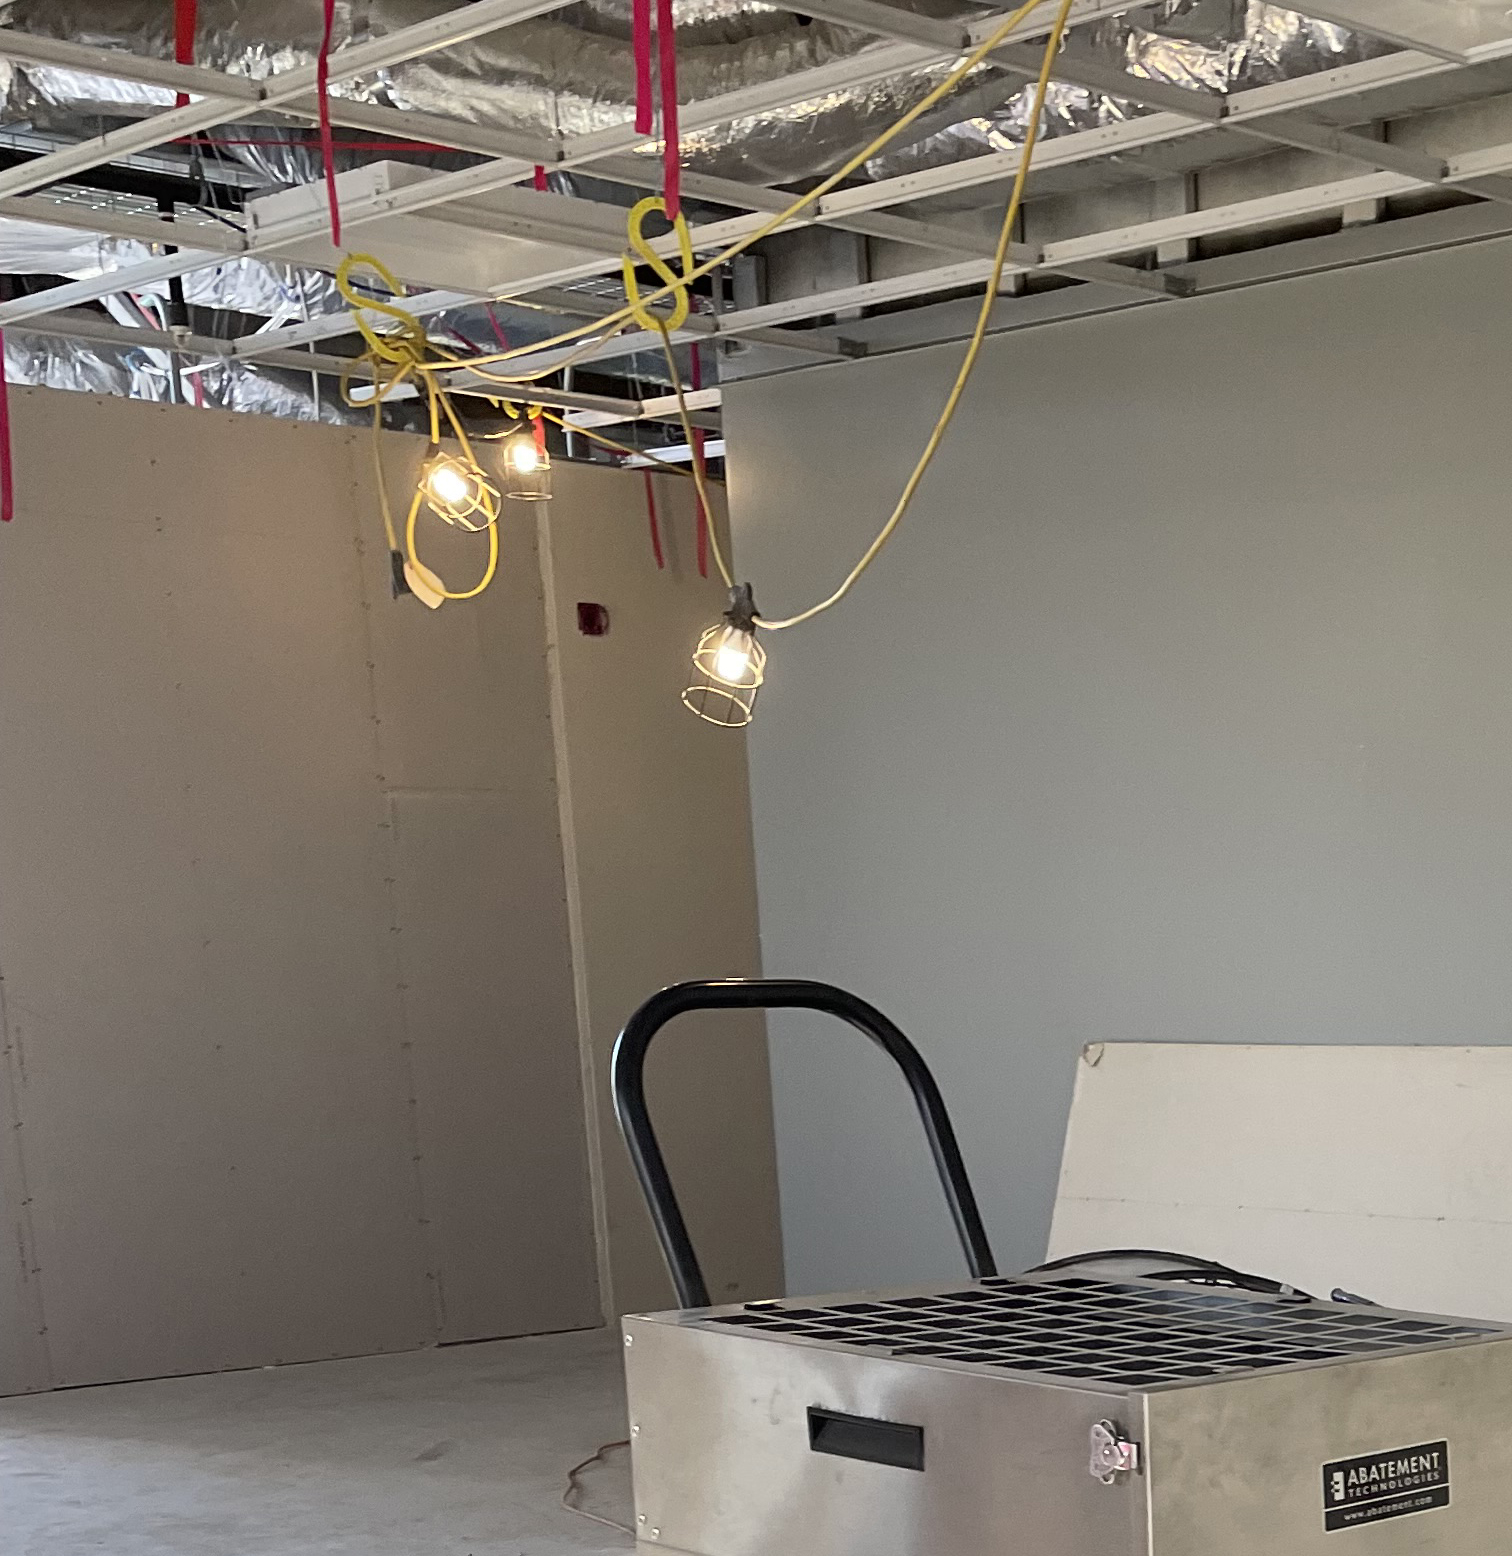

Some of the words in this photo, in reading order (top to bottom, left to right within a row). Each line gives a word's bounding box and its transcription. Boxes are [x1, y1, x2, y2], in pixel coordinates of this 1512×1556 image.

[1347, 1451, 1440, 1487] ABATEMENT
[1347, 1470, 1441, 1498] TECHNOLOGIES
[1343, 1496, 1433, 1521] www.abatement.com
